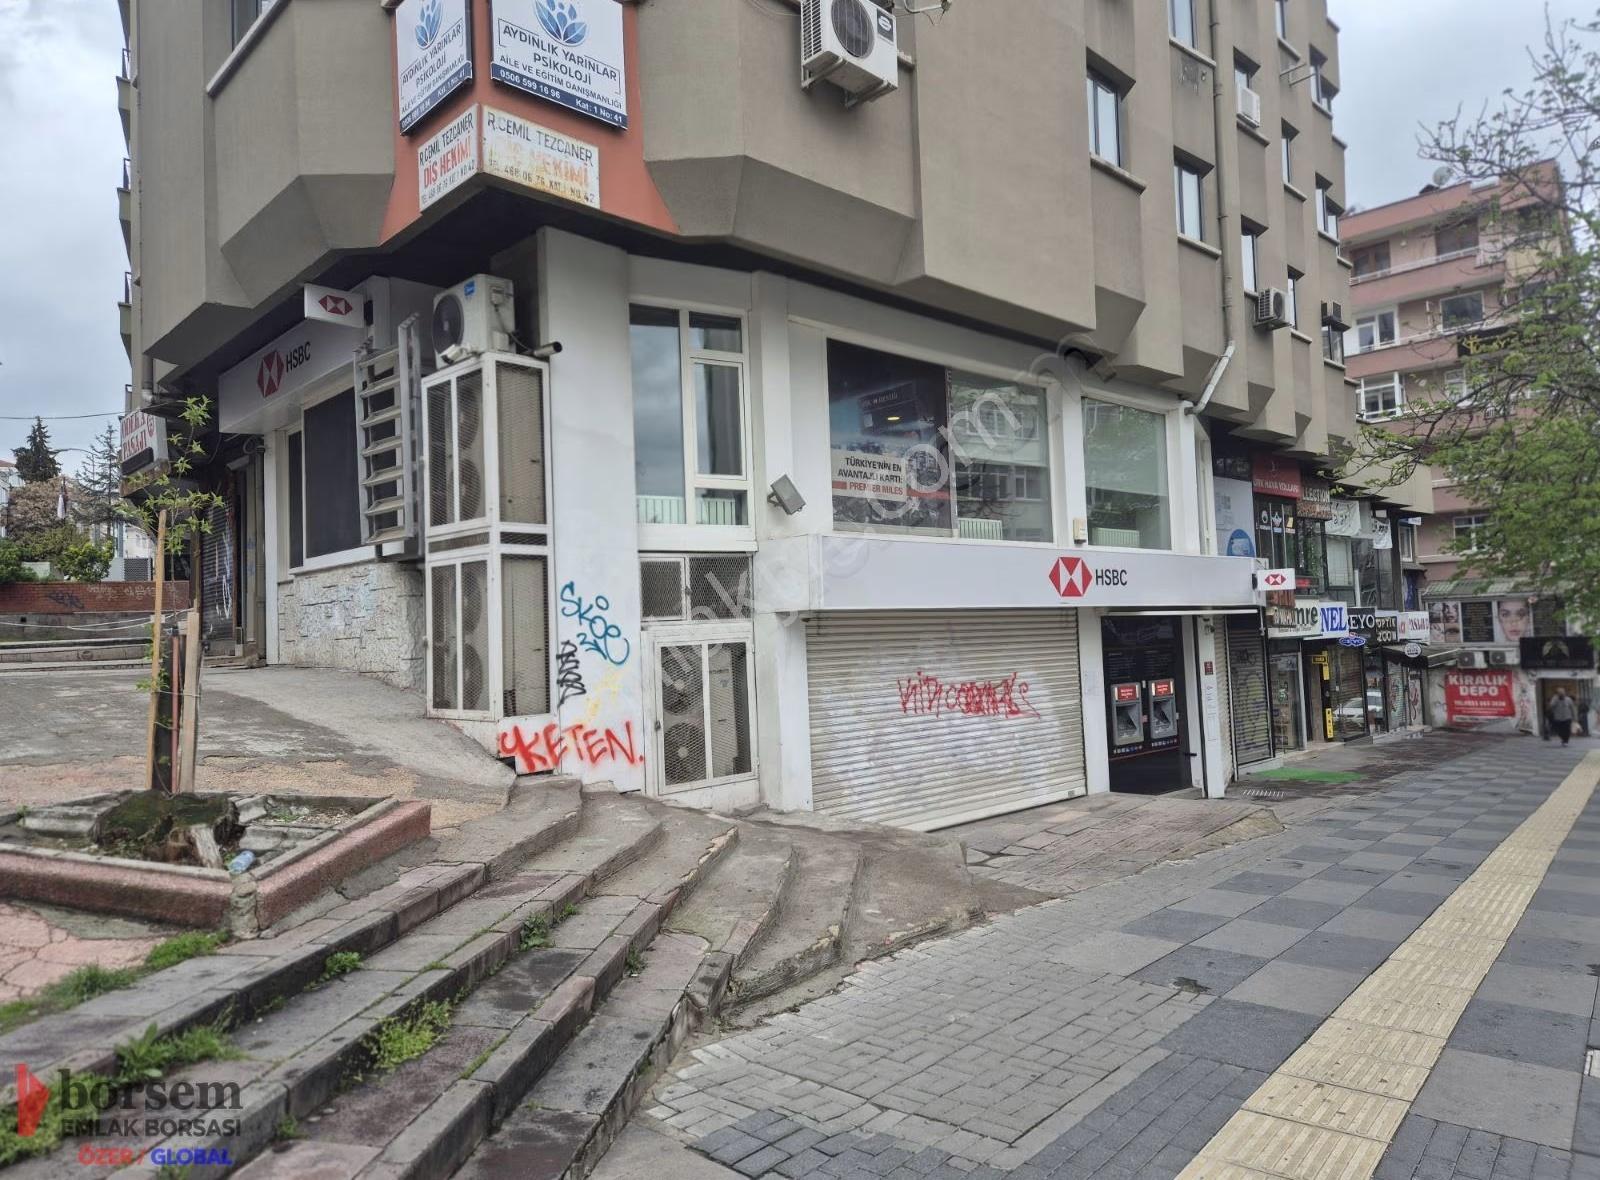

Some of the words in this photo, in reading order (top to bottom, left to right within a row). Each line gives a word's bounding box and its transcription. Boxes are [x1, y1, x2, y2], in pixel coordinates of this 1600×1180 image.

[500, 55, 520, 69] AİLE
[522, 63, 533, 74] VE
[503, 25, 558, 56] AYDINLIK
[563, 49, 617, 81] YARINLAR
[533, 53, 592, 85] PSİKOLOJİ
[500, 69, 520, 83] 0506
[522, 78, 537, 90] 599
[540, 85, 549, 95] 16
[550, 88, 561, 99] 96
[594, 105, 598, 114] 1
[613, 113, 622, 123] 41
[442, 112, 474, 148] TEZCANER
[440, 130, 472, 178] HEKİMİ
[536, 130, 594, 167] TEZCANER
[285, 341, 311, 373] HSBC
[892, 464, 902, 472] EN
[849, 481, 881, 493] PREMER
[1095, 569, 1128, 586] HSBC
[1459, 686, 1499, 697] DEPO
